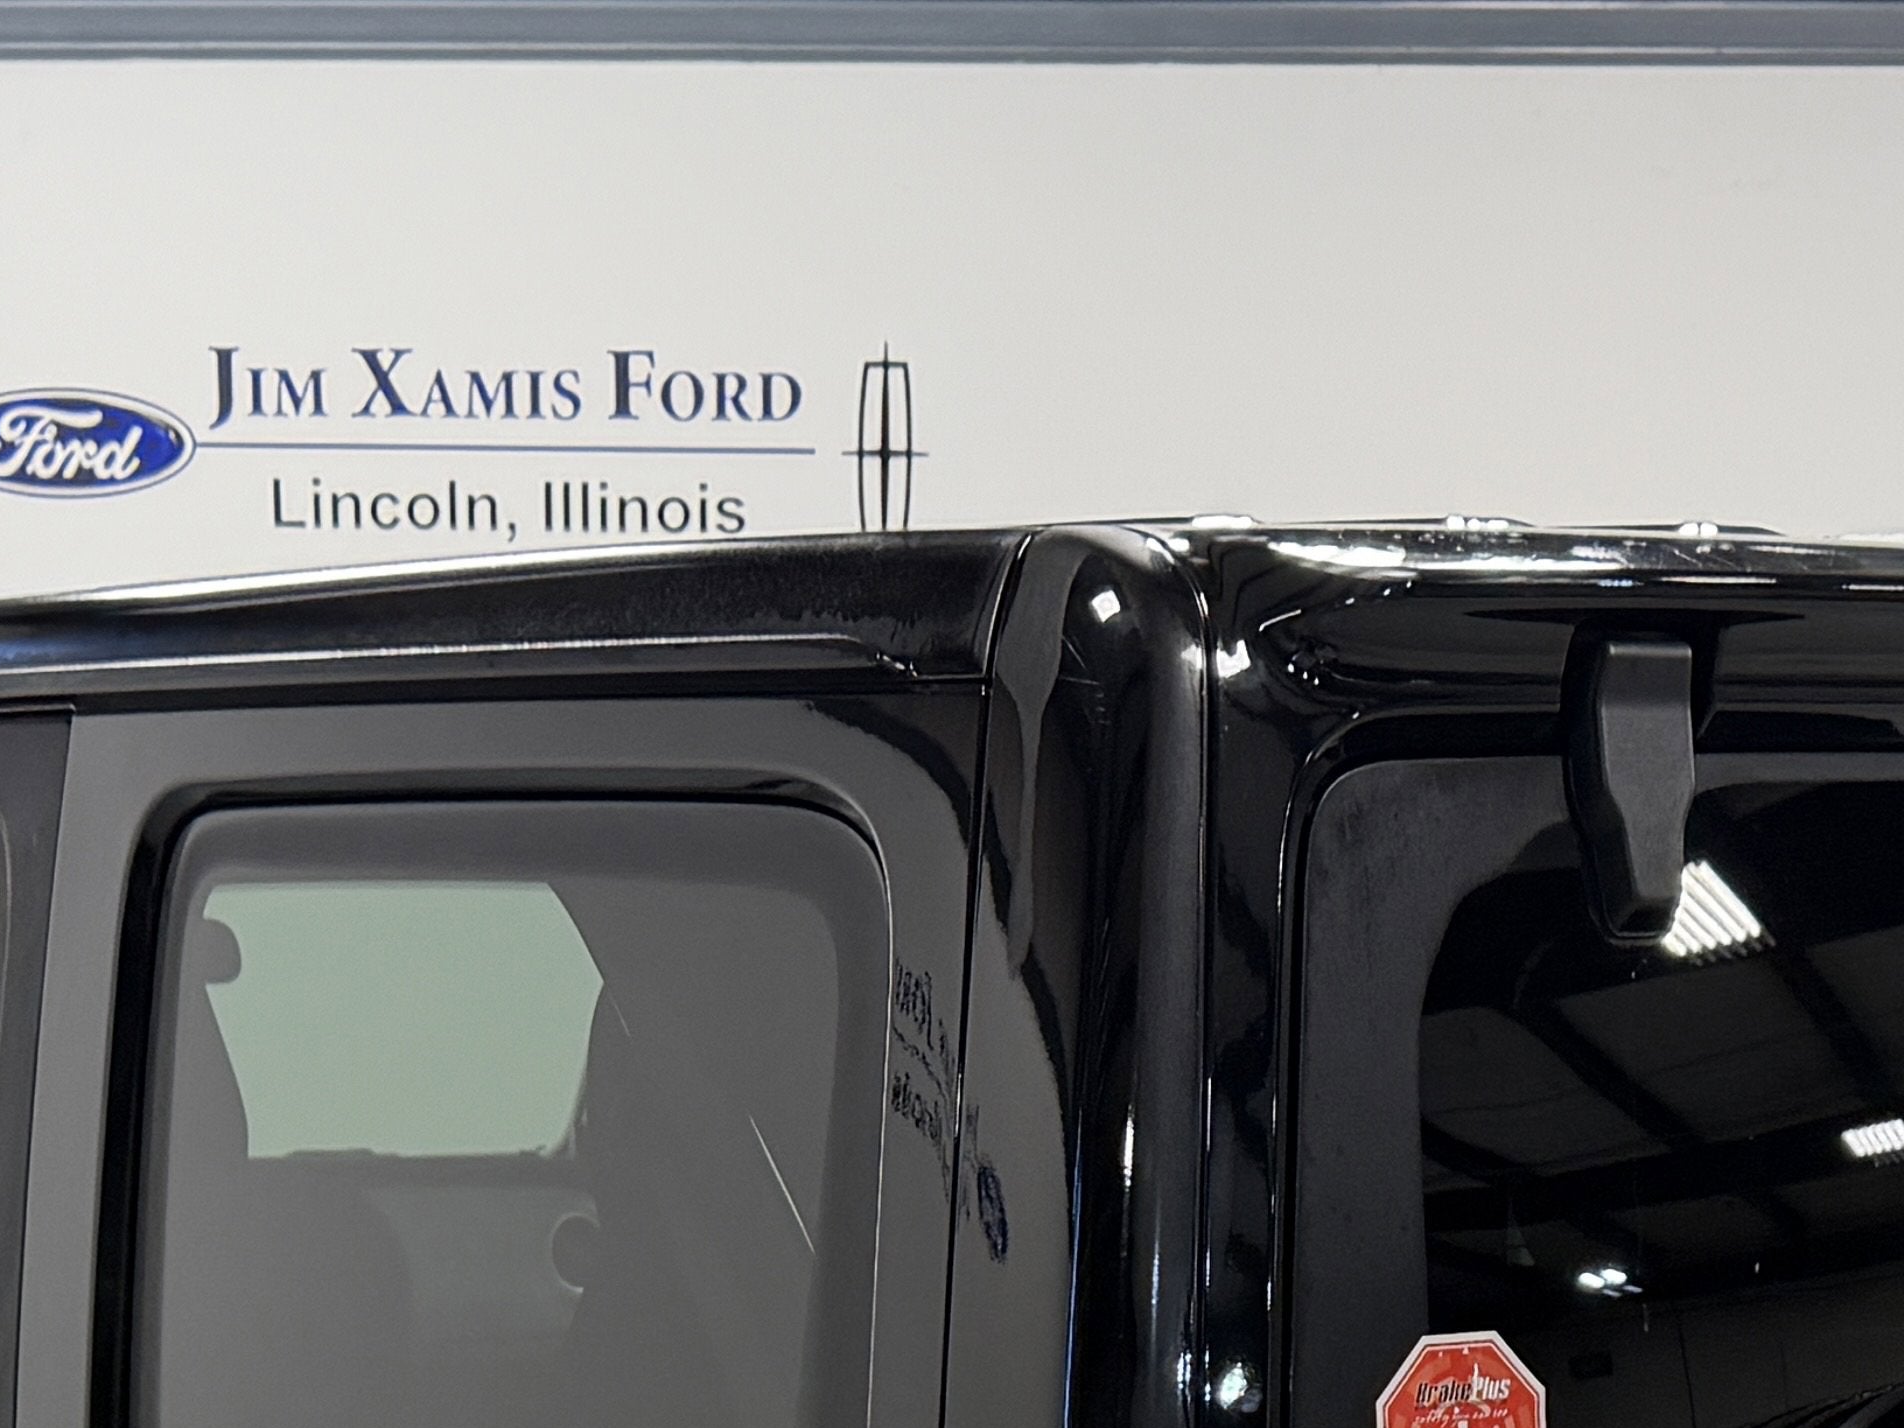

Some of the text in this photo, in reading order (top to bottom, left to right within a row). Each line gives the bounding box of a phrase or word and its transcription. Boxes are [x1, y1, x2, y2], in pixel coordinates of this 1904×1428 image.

[208, 345, 803, 431] JIM XAMIS FORD
[272, 476, 746, 544] Lincoln, Illinois
